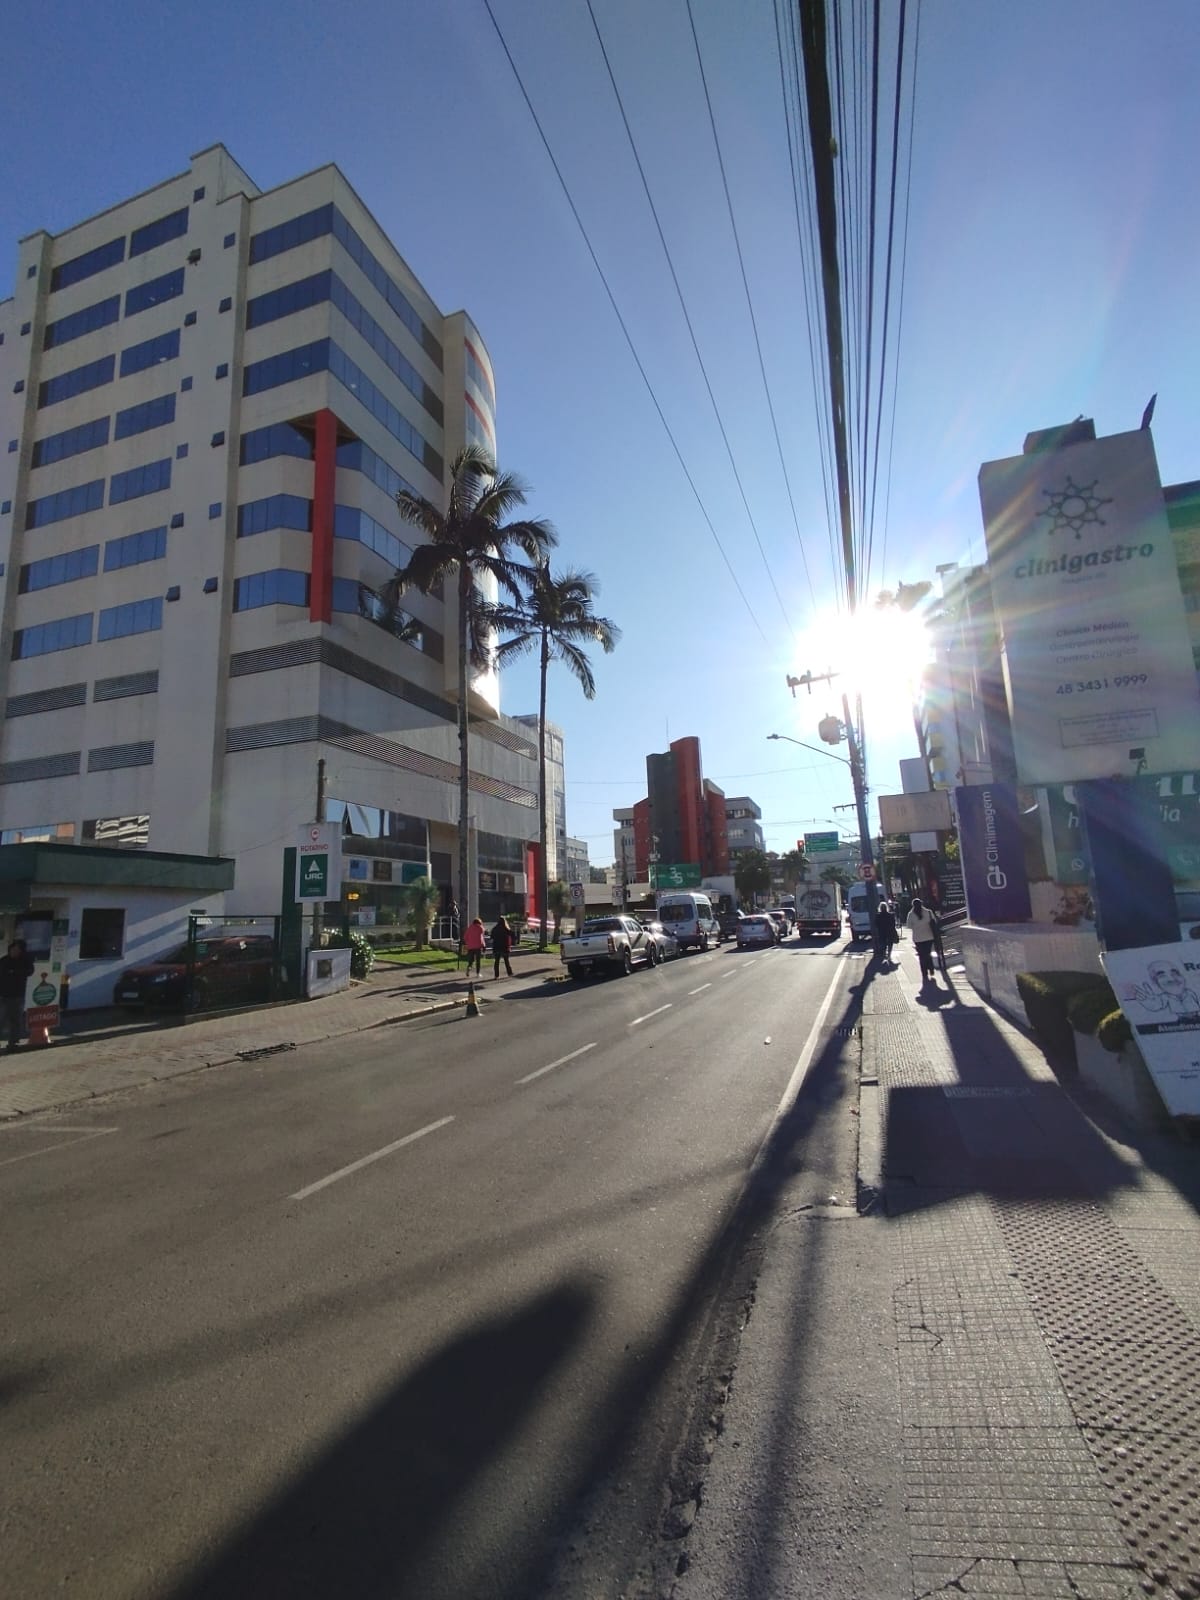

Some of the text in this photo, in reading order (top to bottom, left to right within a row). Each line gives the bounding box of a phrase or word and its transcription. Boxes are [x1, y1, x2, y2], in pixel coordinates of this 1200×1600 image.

[1014, 543, 1154, 579] clinigastro
[1056, 673, 1148, 695] 48 3431 9999
